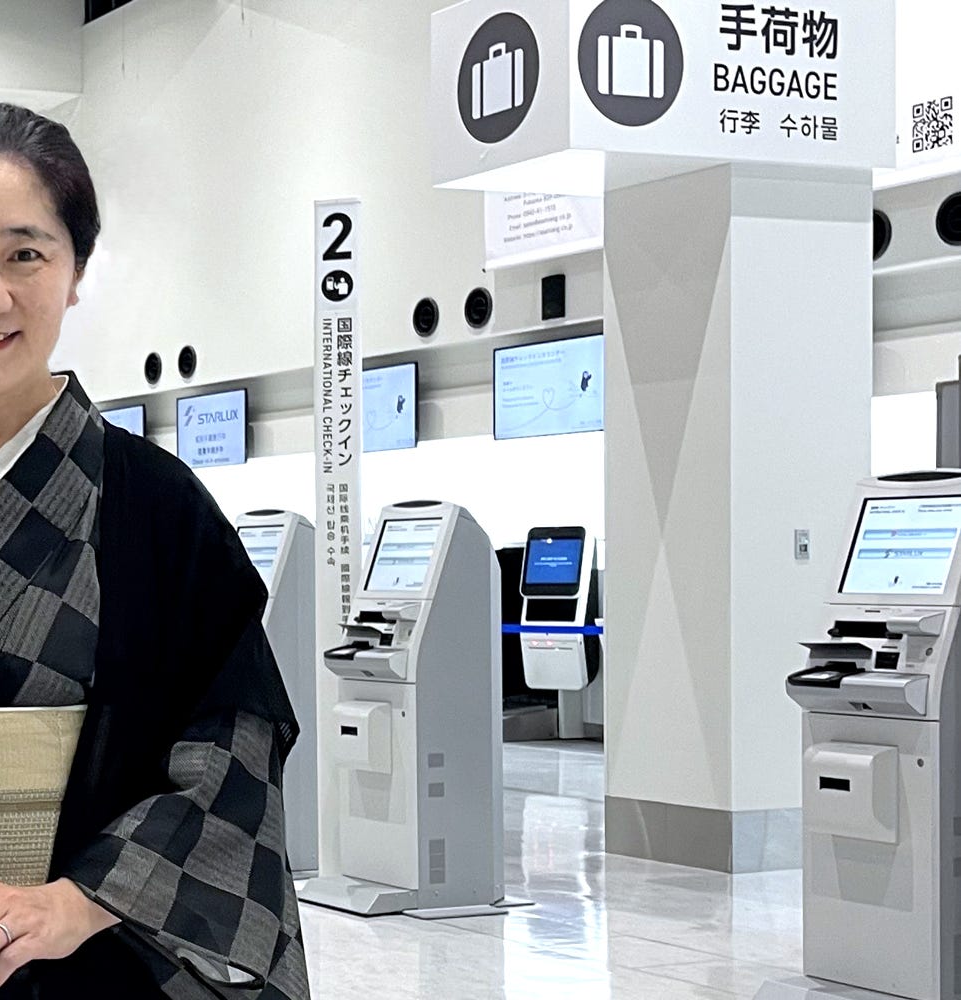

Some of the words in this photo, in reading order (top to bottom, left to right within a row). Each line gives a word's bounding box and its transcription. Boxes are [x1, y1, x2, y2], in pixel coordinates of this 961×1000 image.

[719, 4, 838, 59] 手荷物
[714, 63, 837, 101] BAGGAGE
[719, 108, 760, 135] 行李
[780, 113, 838, 141] 수하물
[322, 212, 353, 262] 2
[322, 318, 333, 413] INTERNATIONAL
[197, 408, 239, 425] STARLUX
[337, 317, 353, 466] 国際線チェックイン
[322, 416, 333, 474] CHECK-IN
